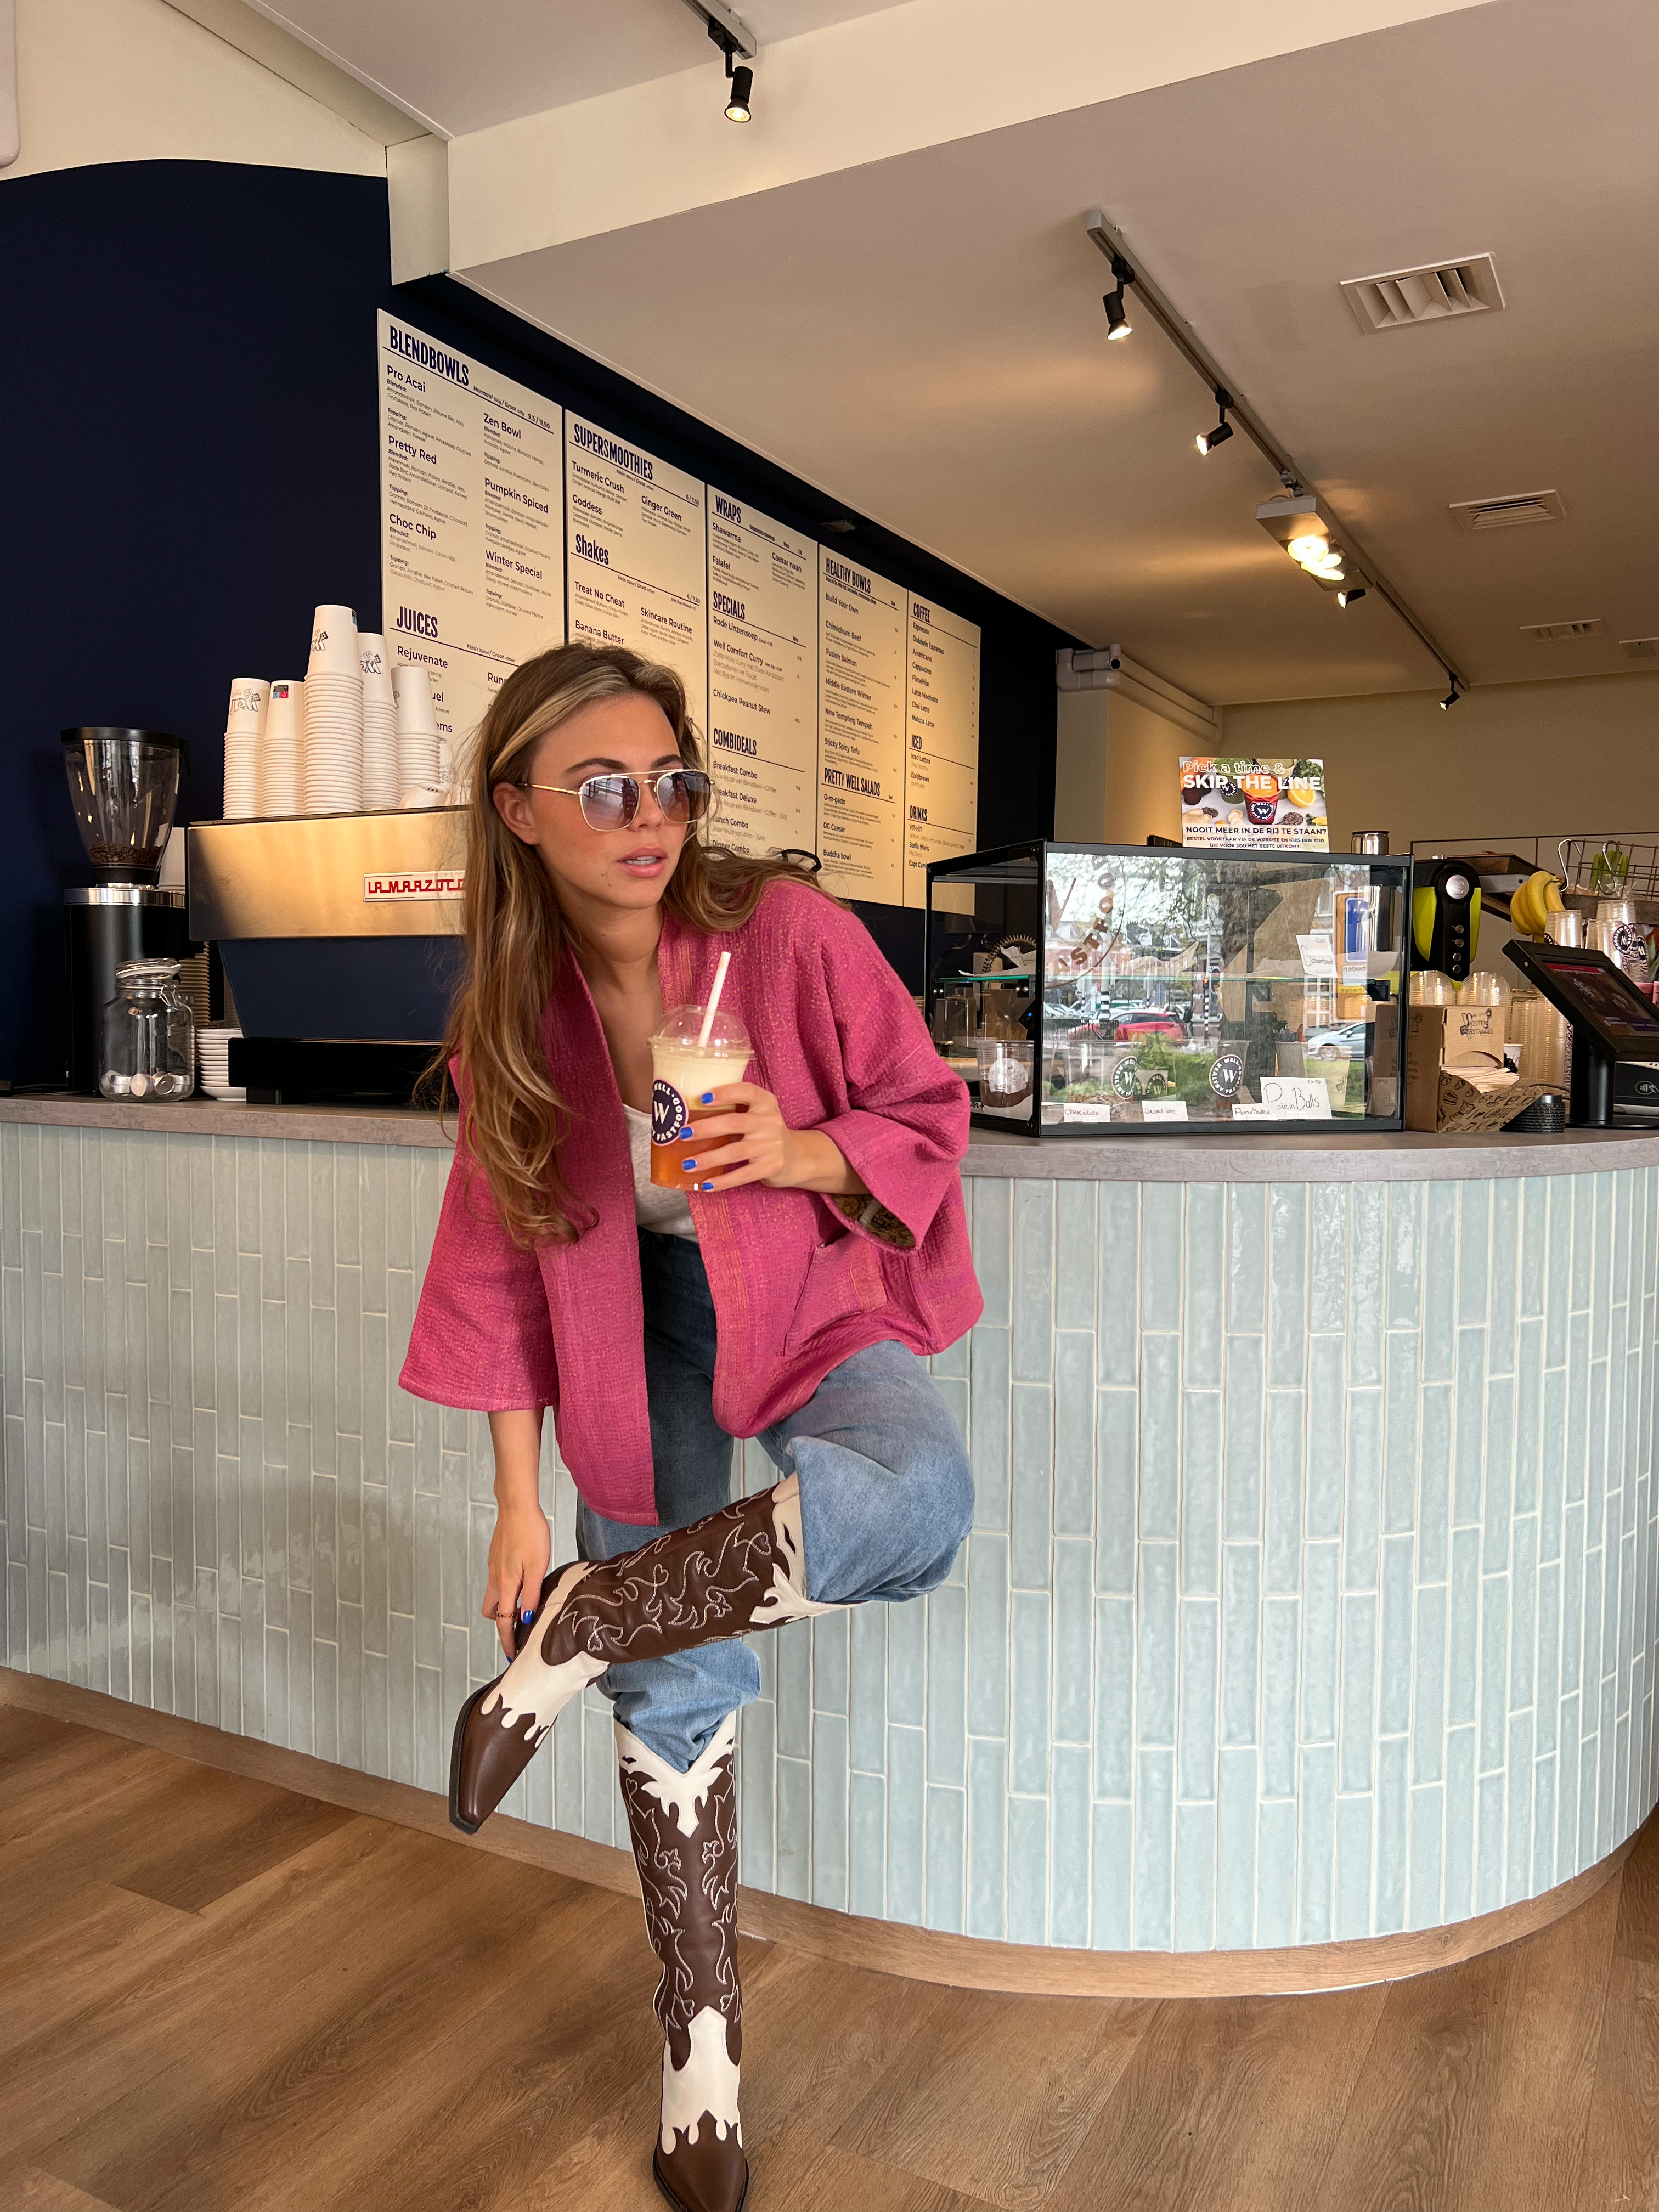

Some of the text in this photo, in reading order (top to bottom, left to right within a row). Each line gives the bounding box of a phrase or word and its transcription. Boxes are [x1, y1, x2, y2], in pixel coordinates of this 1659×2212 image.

[390, 325, 469, 386] BLENDBOWLS
[387, 364, 425, 392] Pro Acai
[387, 379, 407, 392] Blended:
[473, 385, 517, 412] Normaal Groot
[387, 407, 407, 421] Topping:
[483, 413, 521, 439] Zen Bowl
[388, 435, 437, 465] Pretty Red
[388, 448, 408, 461] Blended:
[574, 423, 653, 481] SUPERSMOOTHIES
[572, 460, 603, 483] Turmeric
[605, 477, 624, 494] Crush
[389, 483, 408, 496] Topping:
[484, 477, 548, 514] Pumpkin Spiced
[572, 494, 602, 515] Goddess
[641, 495, 682, 522] Ginger Green
[715, 494, 741, 524] WRAPS
[389, 526, 409, 538] Blended:
[390, 513, 436, 540] Choc Chip
[712, 522, 741, 543] Shawarma
[575, 533, 609, 565] Shakes
[390, 554, 409, 566] Topping:
[485, 549, 542, 579] Winter Special
[712, 555, 730, 570] Falafel
[771, 552, 802, 573] Caesar naan
[826, 557, 851, 584] HEALTHY
[851, 571, 871, 594] BOWLS
[574, 580, 592, 596] Treat
[594, 588, 603, 600] No
[605, 593, 625, 608] Cheat
[826, 592, 859, 614] Build Your Own
[713, 591, 745, 620] SPECIALS
[913, 602, 930, 623] COFFEE
[396, 606, 438, 638] JUICES
[640, 607, 668, 624] Skincare
[669, 618, 692, 634] Routine
[713, 616, 758, 642] Rode Linzensoep
[913, 622, 929, 635] Espresso
[575, 620, 601, 636] Banana
[603, 629, 624, 645] Butter
[851, 631, 861, 642] Beef
[466, 643, 504, 659] Klein Groot
[713, 639, 763, 666] Well Comfort Curry
[912, 635, 944, 655] Dubbele Espresso
[912, 648, 932, 662] Americano
[397, 645, 448, 668] Rejuvenate
[826, 648, 857, 667] Fusion Salmon
[825, 677, 871, 701] Middle Eastern Winter
[912, 674, 929, 687] Flatwhite
[713, 689, 771, 715] Chickpea Peanut Stew
[912, 687, 921, 697] Latte
[911, 701, 930, 713] Chai Latte
[825, 707, 873, 730] New Tempting Tempeh
[911, 714, 934, 728] Matcha Latte
[713, 727, 757, 756] COMBIDEALS
[825, 737, 860, 755] Sticky Spicy Tofu
[911, 733, 922, 750] ICED
[911, 752, 930, 764] Iced Lattes
[1183, 760, 1285, 775] Pick a time &
[713, 760, 758, 779] Breakfast Combo
[910, 771, 929, 783] Coldbrews
[824, 767, 880, 797] PRETTY WELL SALADS
[1183, 775, 1322, 791] SKIP THE LINE
[715, 786, 757, 804] reakfast Deluxe
[823, 793, 845, 805] O-m-gado
[712, 814, 748, 828] Lunch Combo
[910, 805, 927, 822] DRINKS
[831, 823, 845, 833] Caesar
[731, 843, 750, 854] Combo
[823, 849, 851, 861] Buddha bowl
[909, 841, 919, 849] Stella
[1223, 1069, 1237, 1083] W
[1292, 1087, 1320, 1110] Balls
[653, 1101, 670, 1124] W
